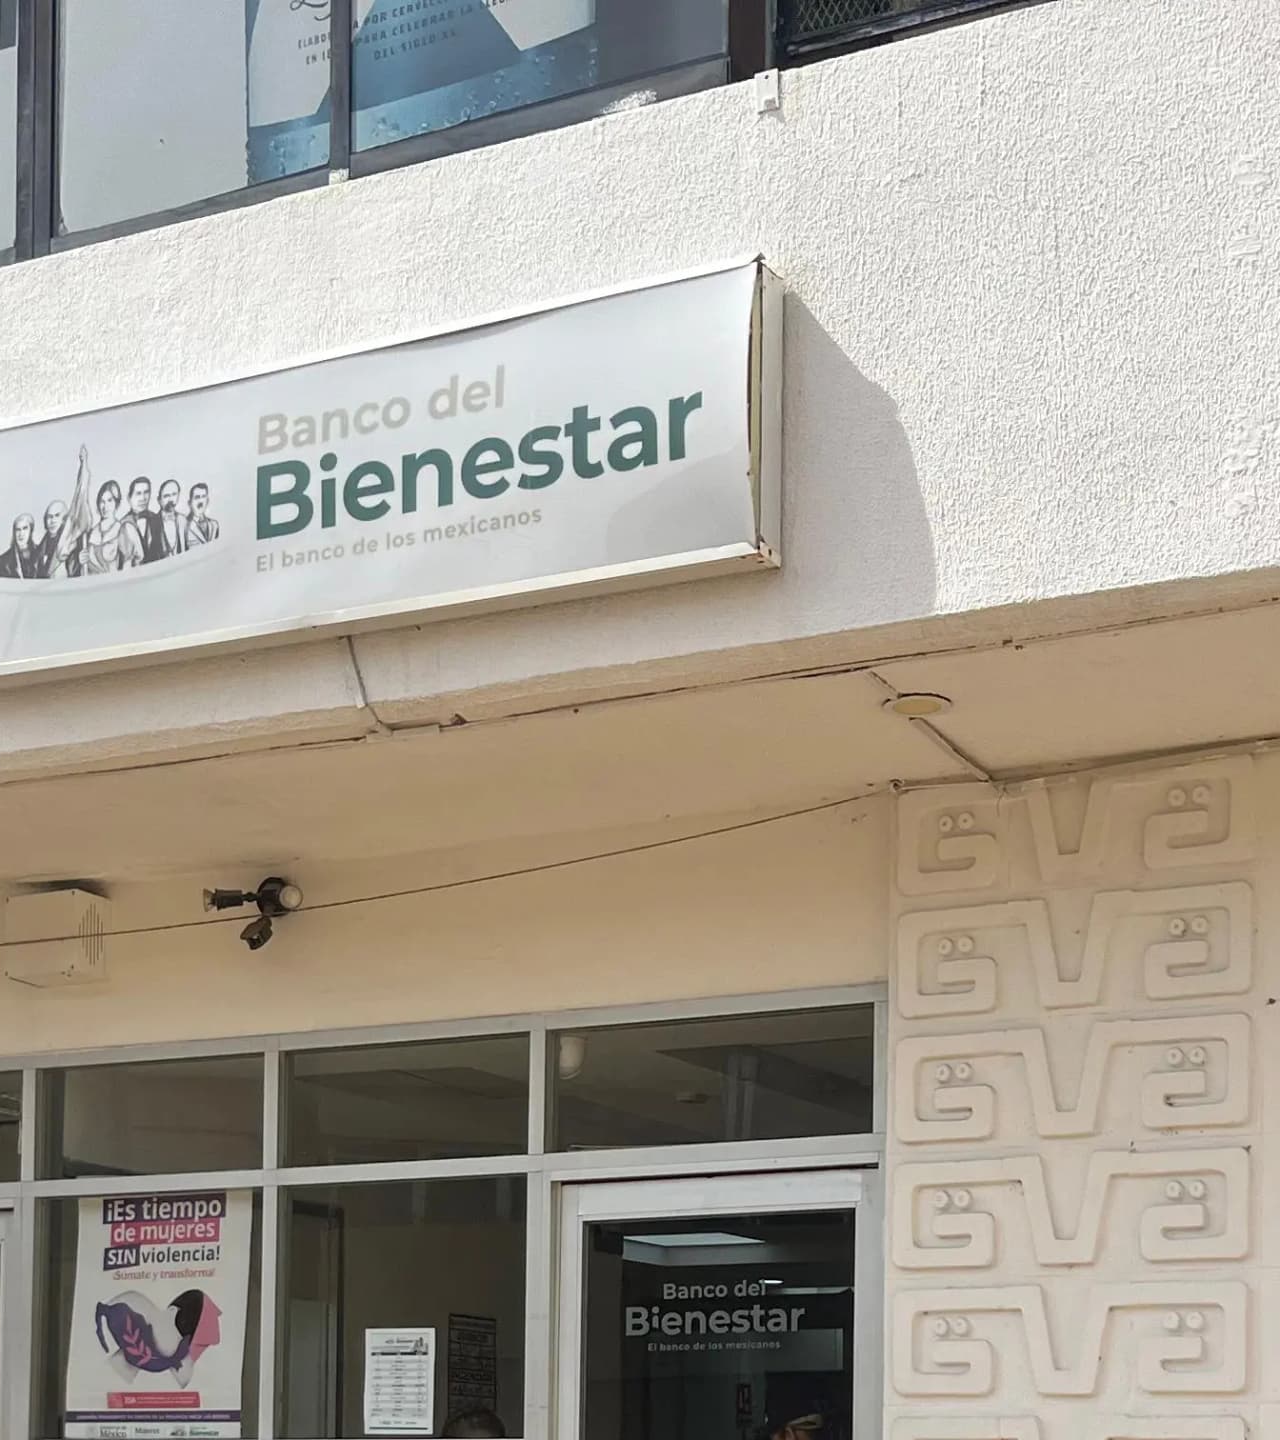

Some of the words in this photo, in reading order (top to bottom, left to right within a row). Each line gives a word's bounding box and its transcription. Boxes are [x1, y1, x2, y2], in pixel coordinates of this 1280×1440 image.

[257, 396, 411, 455] Banco
[427, 365, 505, 420] del
[256, 391, 703, 540] Bienestar
[256, 554, 275, 572] El
[282, 544, 345, 569] banco
[352, 537, 379, 557] de
[386, 531, 415, 550] los
[424, 507, 543, 544] mexicanos
[106, 1200, 136, 1222] ¡Es
[142, 1198, 222, 1222] tiempo
[113, 1222, 136, 1242] de
[140, 1219, 215, 1243] mujeres
[107, 1248, 136, 1265] SIN
[142, 1245, 220, 1264] violencia!
[152, 1272, 158, 1282] y
[662, 1283, 728, 1300] Banco
[733, 1279, 767, 1297] del
[625, 1304, 806, 1336] Bienestar
[647, 1343, 658, 1351] El
[659, 1342, 690, 1352] banco
[693, 1342, 706, 1351] de
[708, 1341, 723, 1350] los
[725, 1340, 781, 1350] mexicanos
